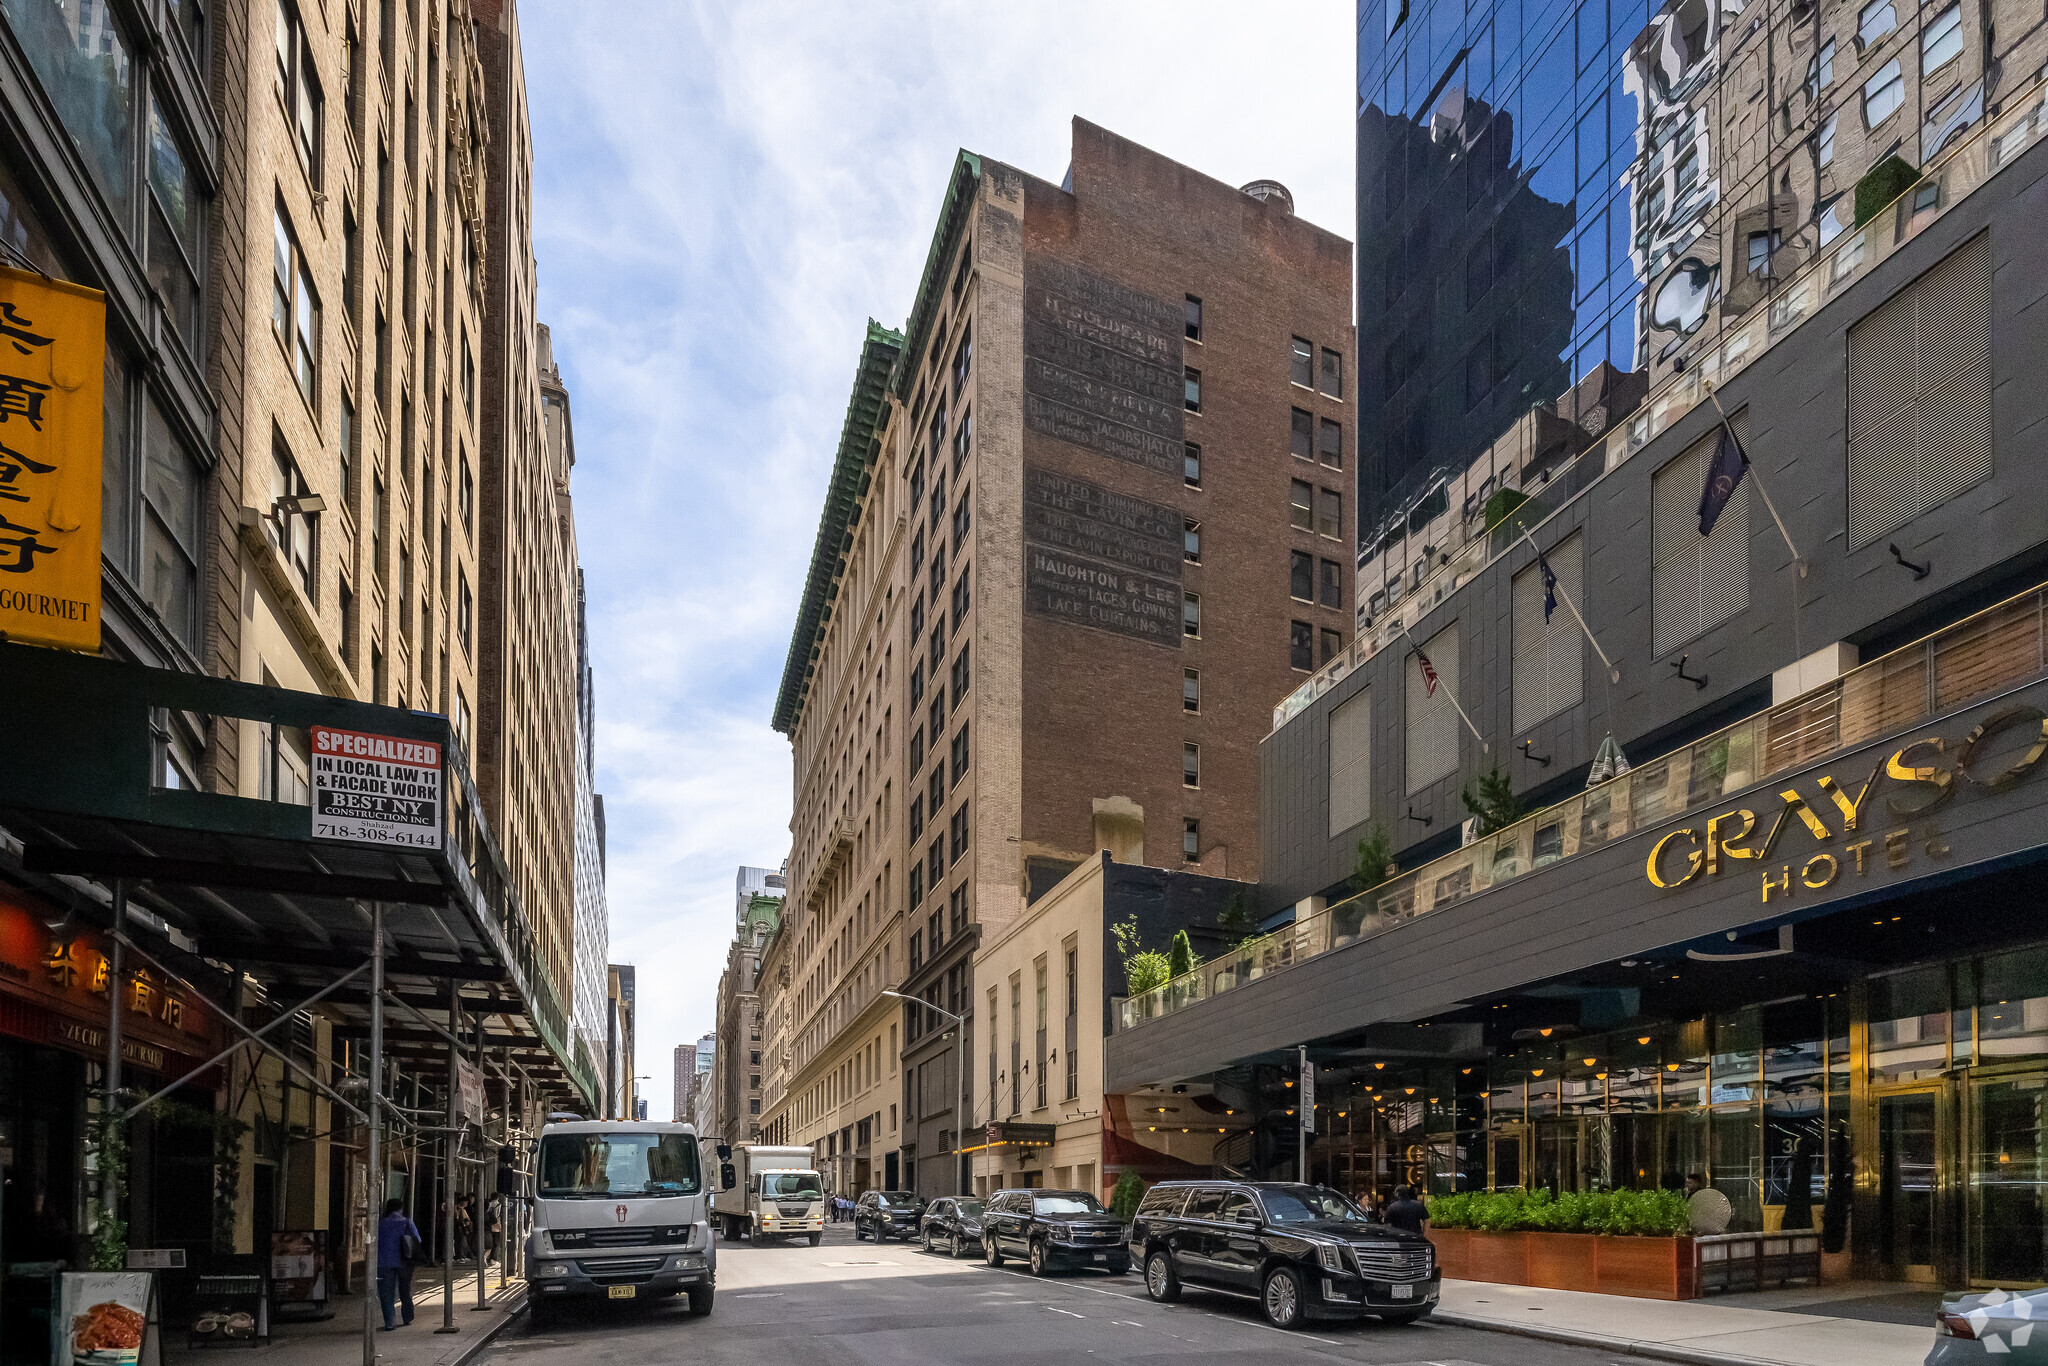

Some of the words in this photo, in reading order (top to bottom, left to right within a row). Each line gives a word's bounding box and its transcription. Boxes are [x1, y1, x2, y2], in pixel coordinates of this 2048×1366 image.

[1037, 472, 1089, 500] UNITED
[1100, 491, 1152, 519] TRIMMING
[1041, 489, 1074, 510] THE
[1085, 502, 1135, 528] LAVIN
[1034, 553, 1117, 591] HAUGHTON
[1125, 579, 1140, 595] &
[1144, 582, 1175, 605] LEE
[0, 588, 91, 622] GOURMET
[1047, 594, 1081, 616] LACE
[1088, 586, 1126, 610] LACES
[317, 731, 437, 765] SPECIALIZED
[316, 756, 333, 772] IN
[336, 759, 383, 778] LOCAL
[386, 765, 419, 783] LAW
[421, 771, 437, 785] 11
[316, 774, 328, 788] &
[331, 774, 388, 795] FACADE
[391, 781, 438, 801] WORK
[325, 806, 409, 822] CONSTRUCTION
[410, 816, 430, 825] INC
[332, 792, 388, 812] BEST
[392, 799, 423, 816] NY
[317, 823, 436, 847] 718-308-6144
[361, 820, 395, 831] Shahzad
[553, 1233, 586, 1241] DAF
